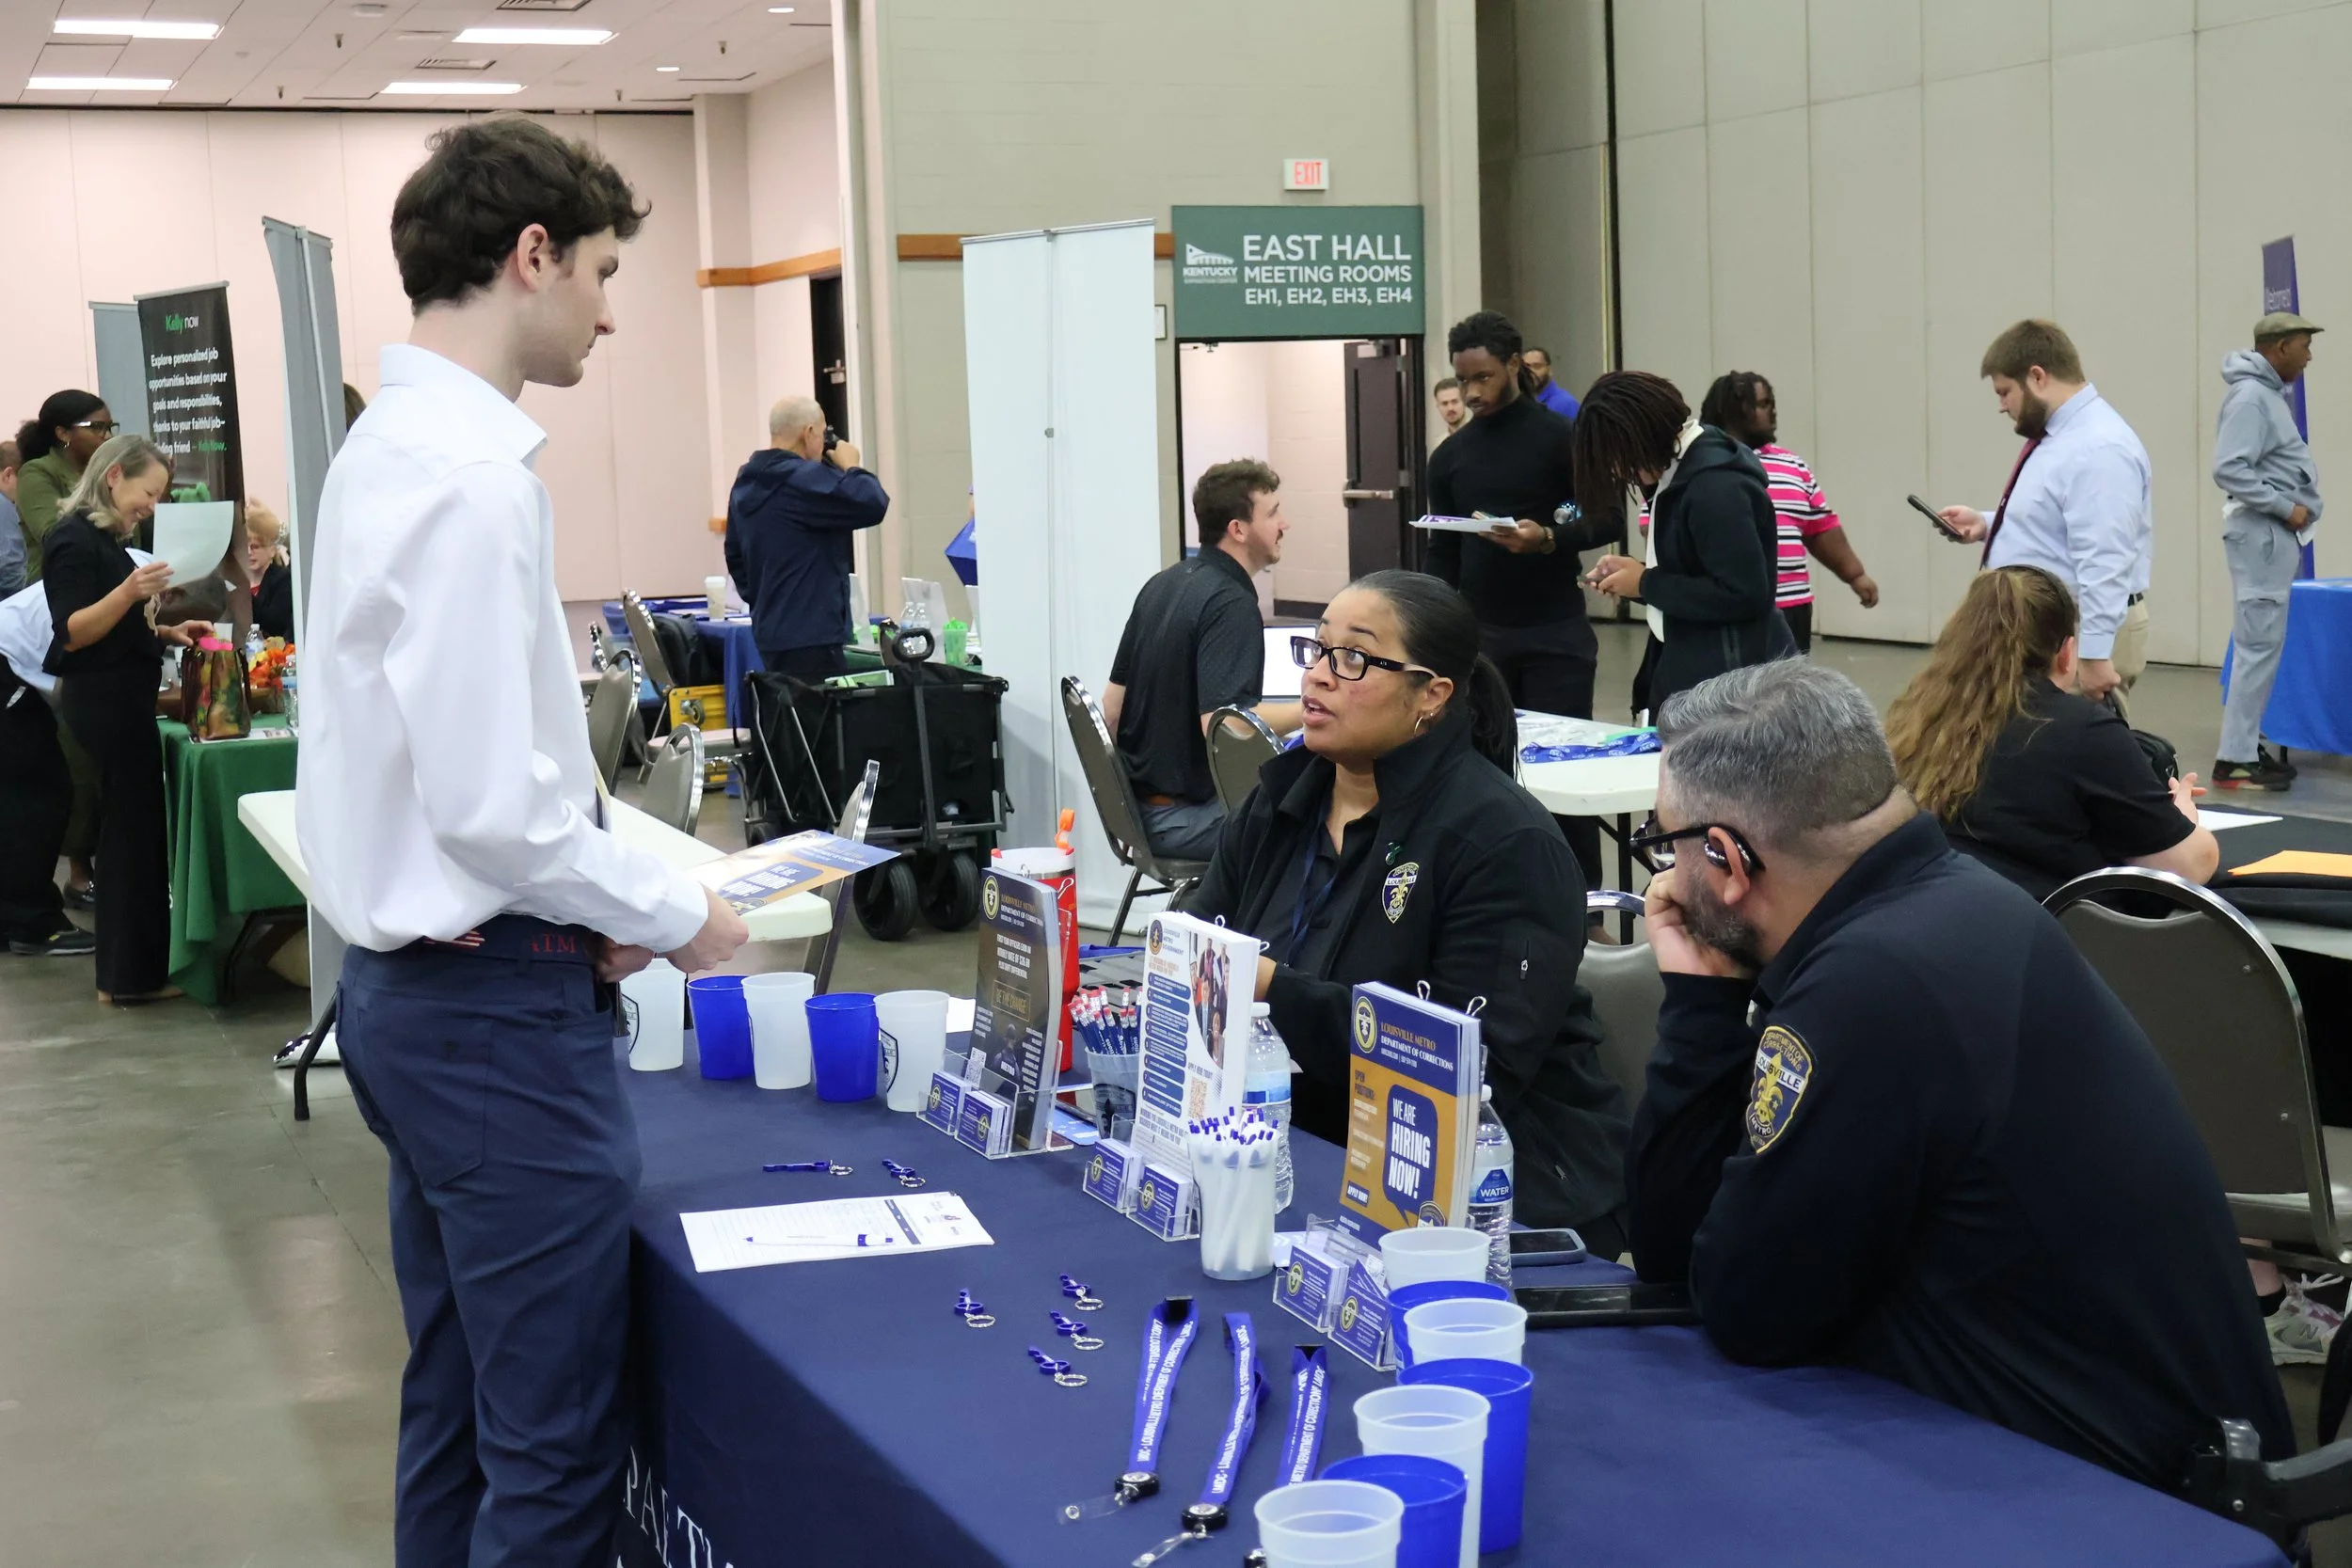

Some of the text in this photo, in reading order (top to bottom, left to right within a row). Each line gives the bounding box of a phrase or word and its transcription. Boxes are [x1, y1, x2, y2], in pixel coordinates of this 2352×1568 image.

[1294, 162, 1322, 186] EXIT
[1243, 235, 1411, 261] EAST HALL
[1183, 267, 1237, 277] KENTUCKY
[1245, 265, 1411, 282] MEETING ROOMS
[1246, 287, 1412, 306] EH1, EH2, EH3, EH4
[166, 314, 199, 334] Kelly now
[151, 348, 218, 368] Explore personalized job
[149, 374, 184, 391] opportunities
[185, 372, 202, 385] based
[210, 372, 227, 385] your
[153, 401, 166, 413] goals
[167, 397, 180, 408] and
[153, 420, 170, 432] thanks
[172, 421, 180, 431] to
[180, 421, 191, 434] your
[192, 418, 211, 430] faithful
[174, 441, 190, 452] friend
[1381, 1022, 1436, 1052] LOUISVILLE METRO
[1381, 1036, 1411, 1055] DEPARTMENT
[1412, 1047, 1419, 1056] OF
[1419, 1050, 1454, 1071] CORRECTIONS
[1392, 1098, 1404, 1119] WE
[1404, 1103, 1416, 1126] ARE
[1751, 1117, 1772, 1136] METRO
[1391, 1121, 1431, 1169] HIRING
[1388, 1155, 1421, 1199] NOW!
[1347, 1185, 1359, 1198] APPLY
[1480, 1186, 1510, 1197] WATER
[1297, 1432, 1313, 1464] DEPARTMENT
